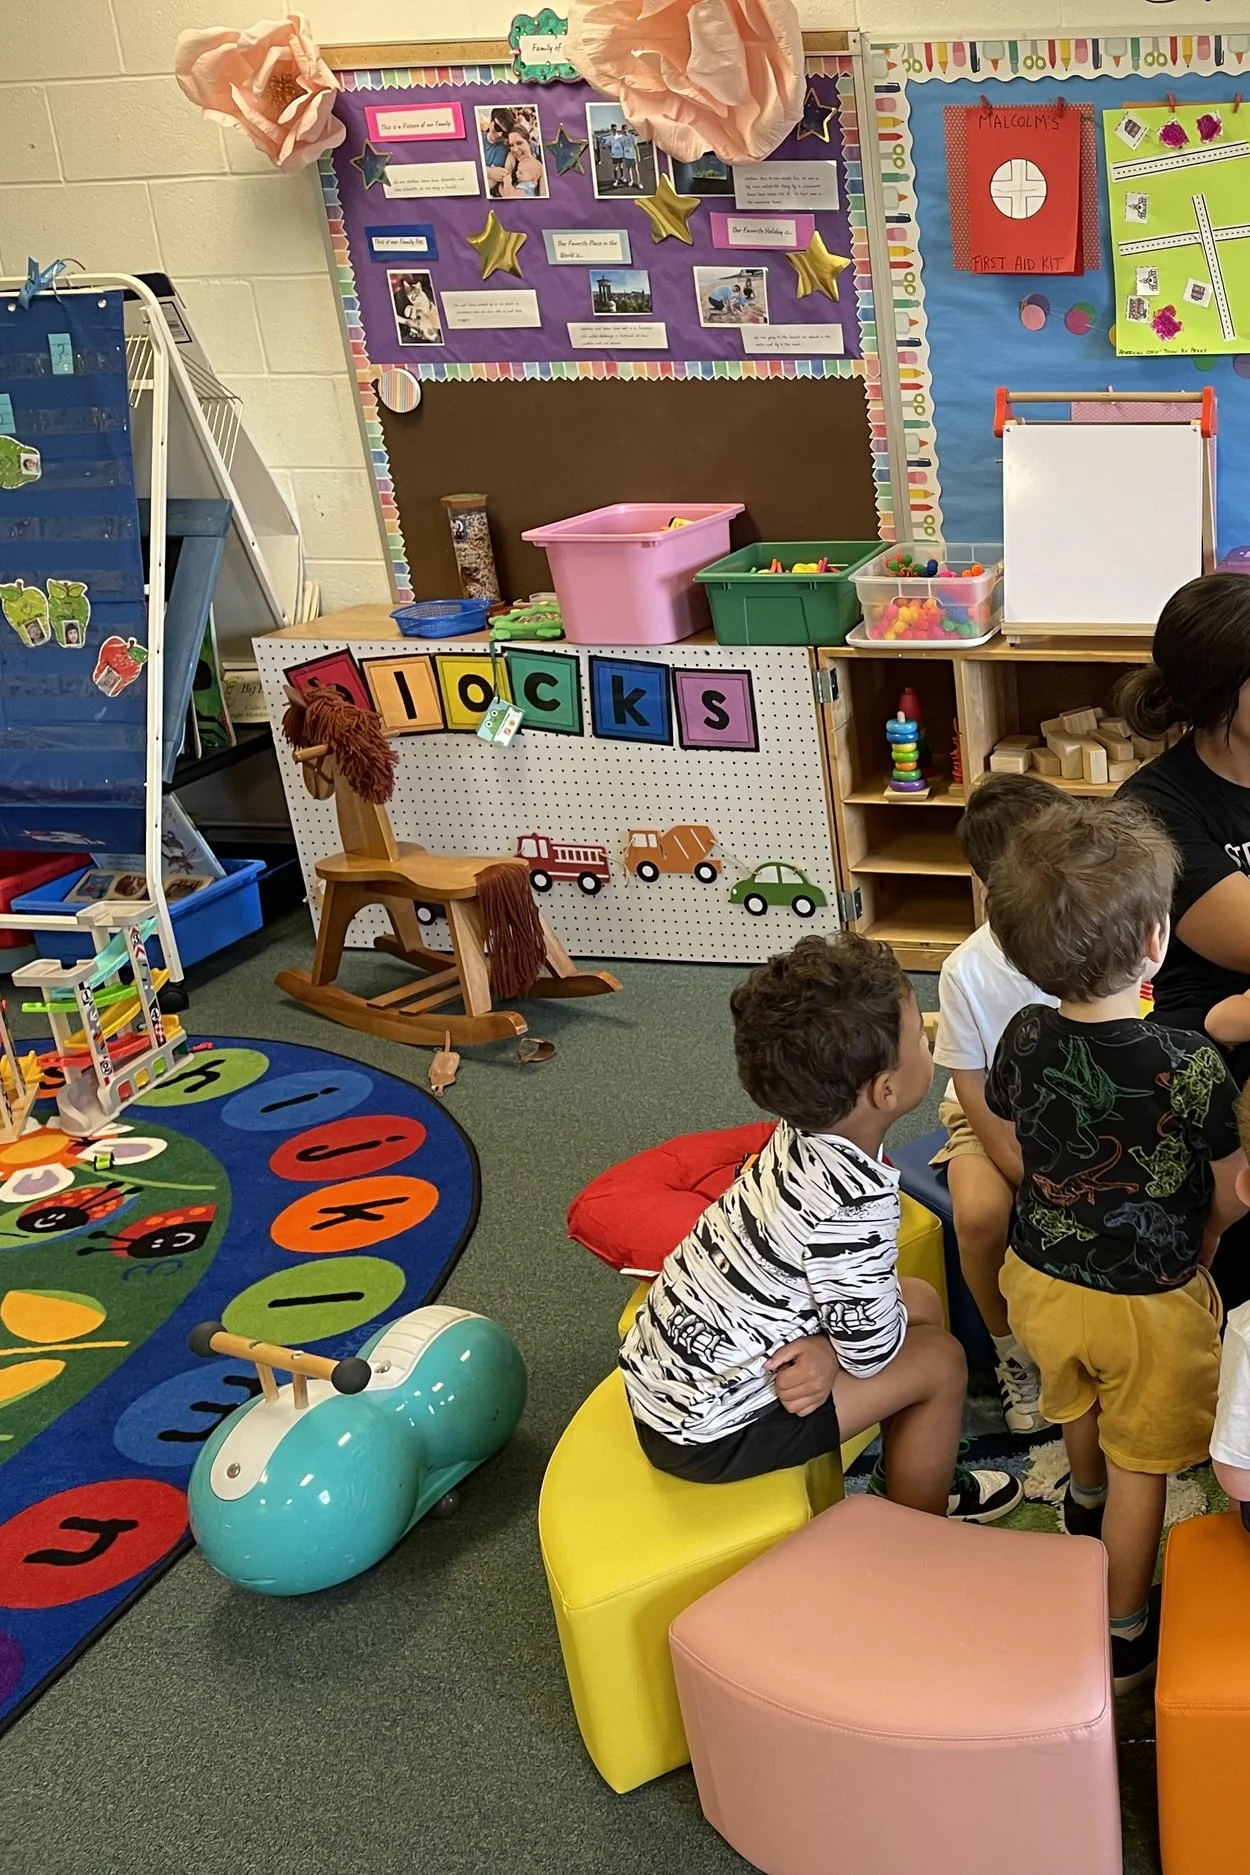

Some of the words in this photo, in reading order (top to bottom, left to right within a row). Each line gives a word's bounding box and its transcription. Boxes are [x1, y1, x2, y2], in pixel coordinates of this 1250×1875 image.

[532, 43, 552, 53] Family
[402, 122, 420, 130] Picture
[435, 120, 452, 128] Family
[978, 114, 1060, 131] MALCOLM'S
[765, 227, 783, 235] Holiday
[971, 255, 1006, 272] FIRST
[1014, 256, 1035, 271] AID
[1042, 256, 1065, 271] KIT
